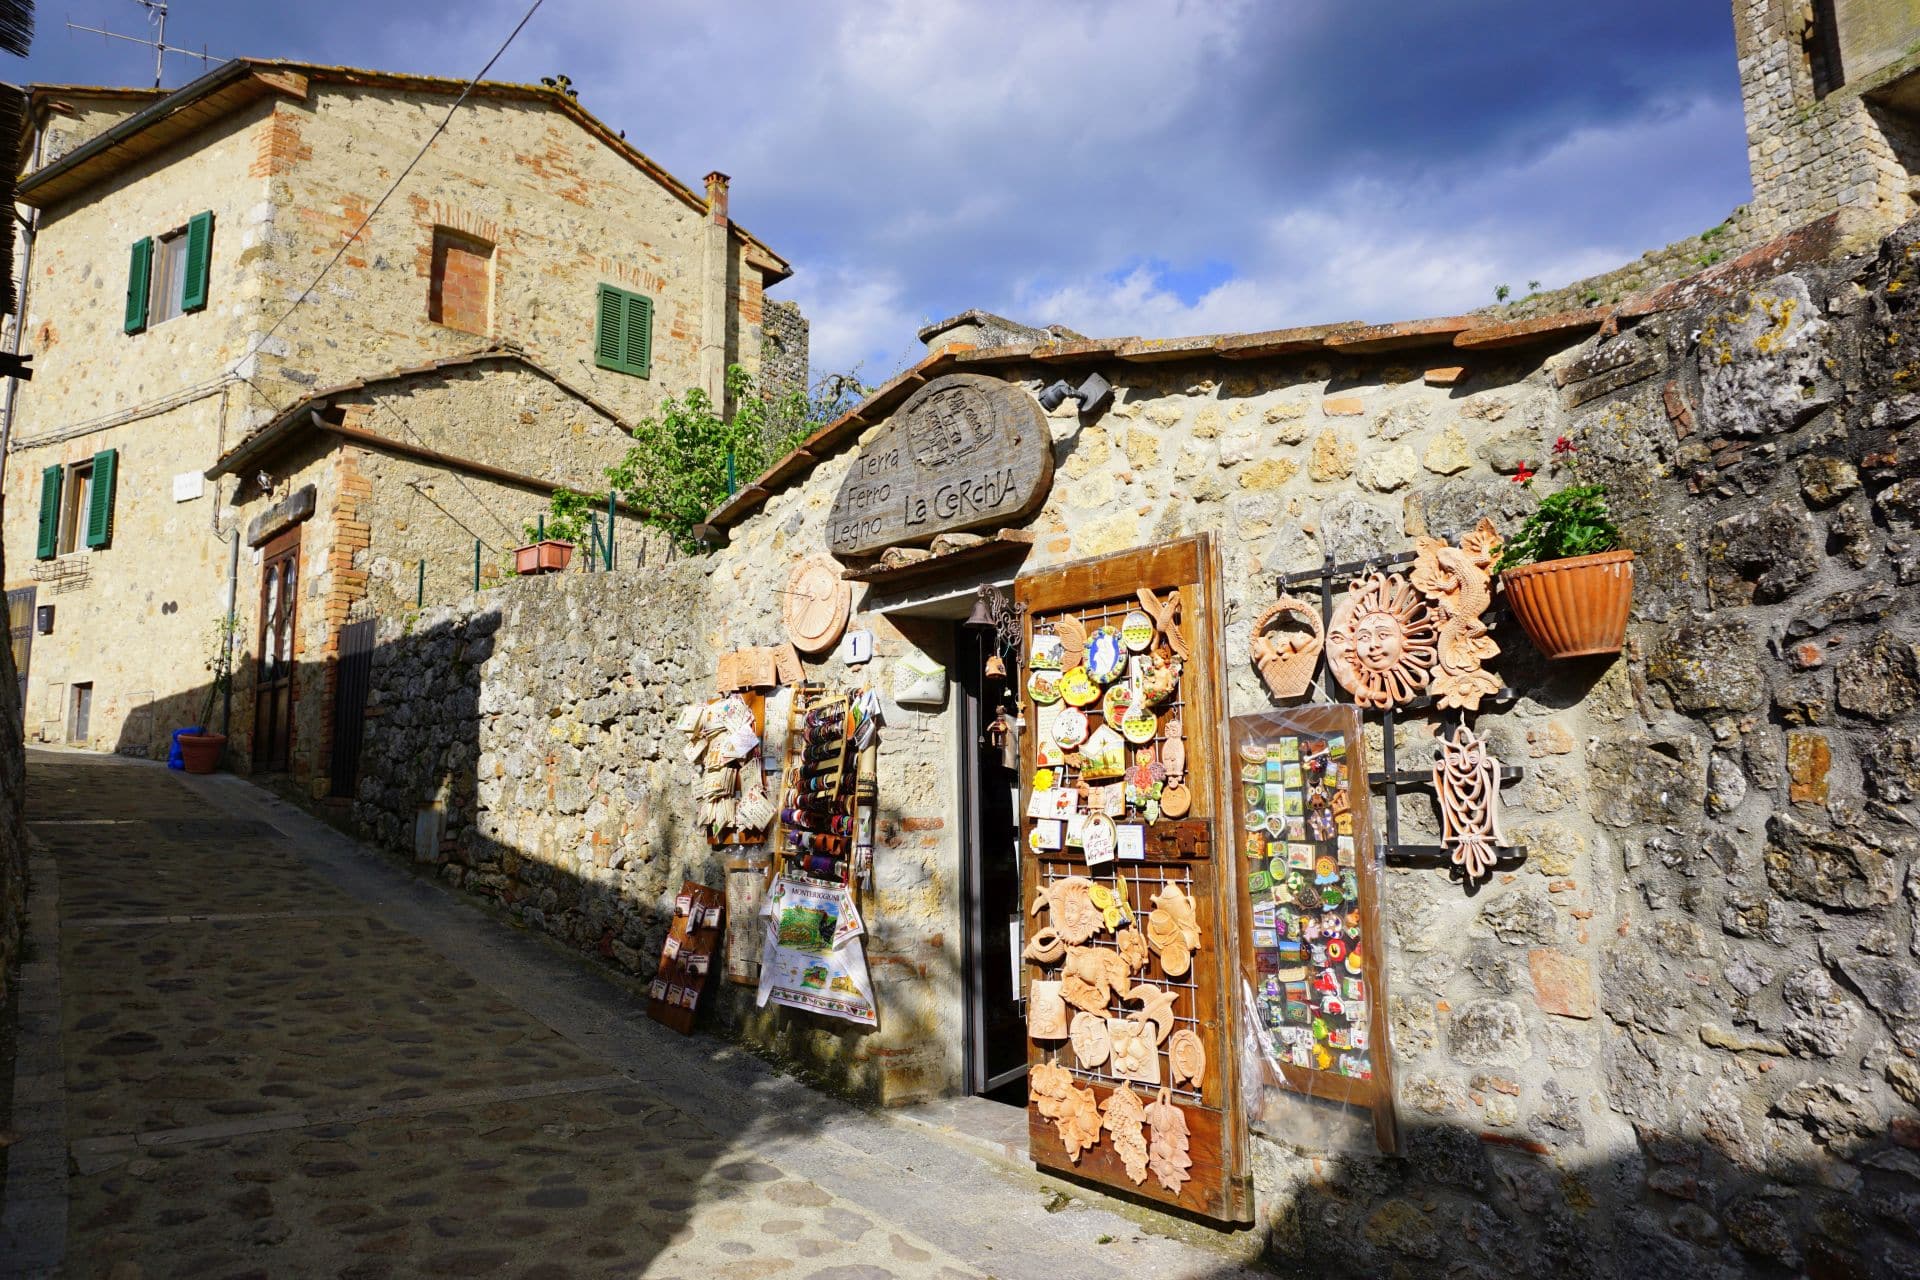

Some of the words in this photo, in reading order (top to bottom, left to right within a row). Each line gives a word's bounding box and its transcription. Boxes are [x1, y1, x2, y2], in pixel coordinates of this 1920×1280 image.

[858, 448, 899, 479] Terra
[847, 483, 891, 512] Ferro
[832, 517, 882, 549] Legno
[851, 637, 858, 656] 1
